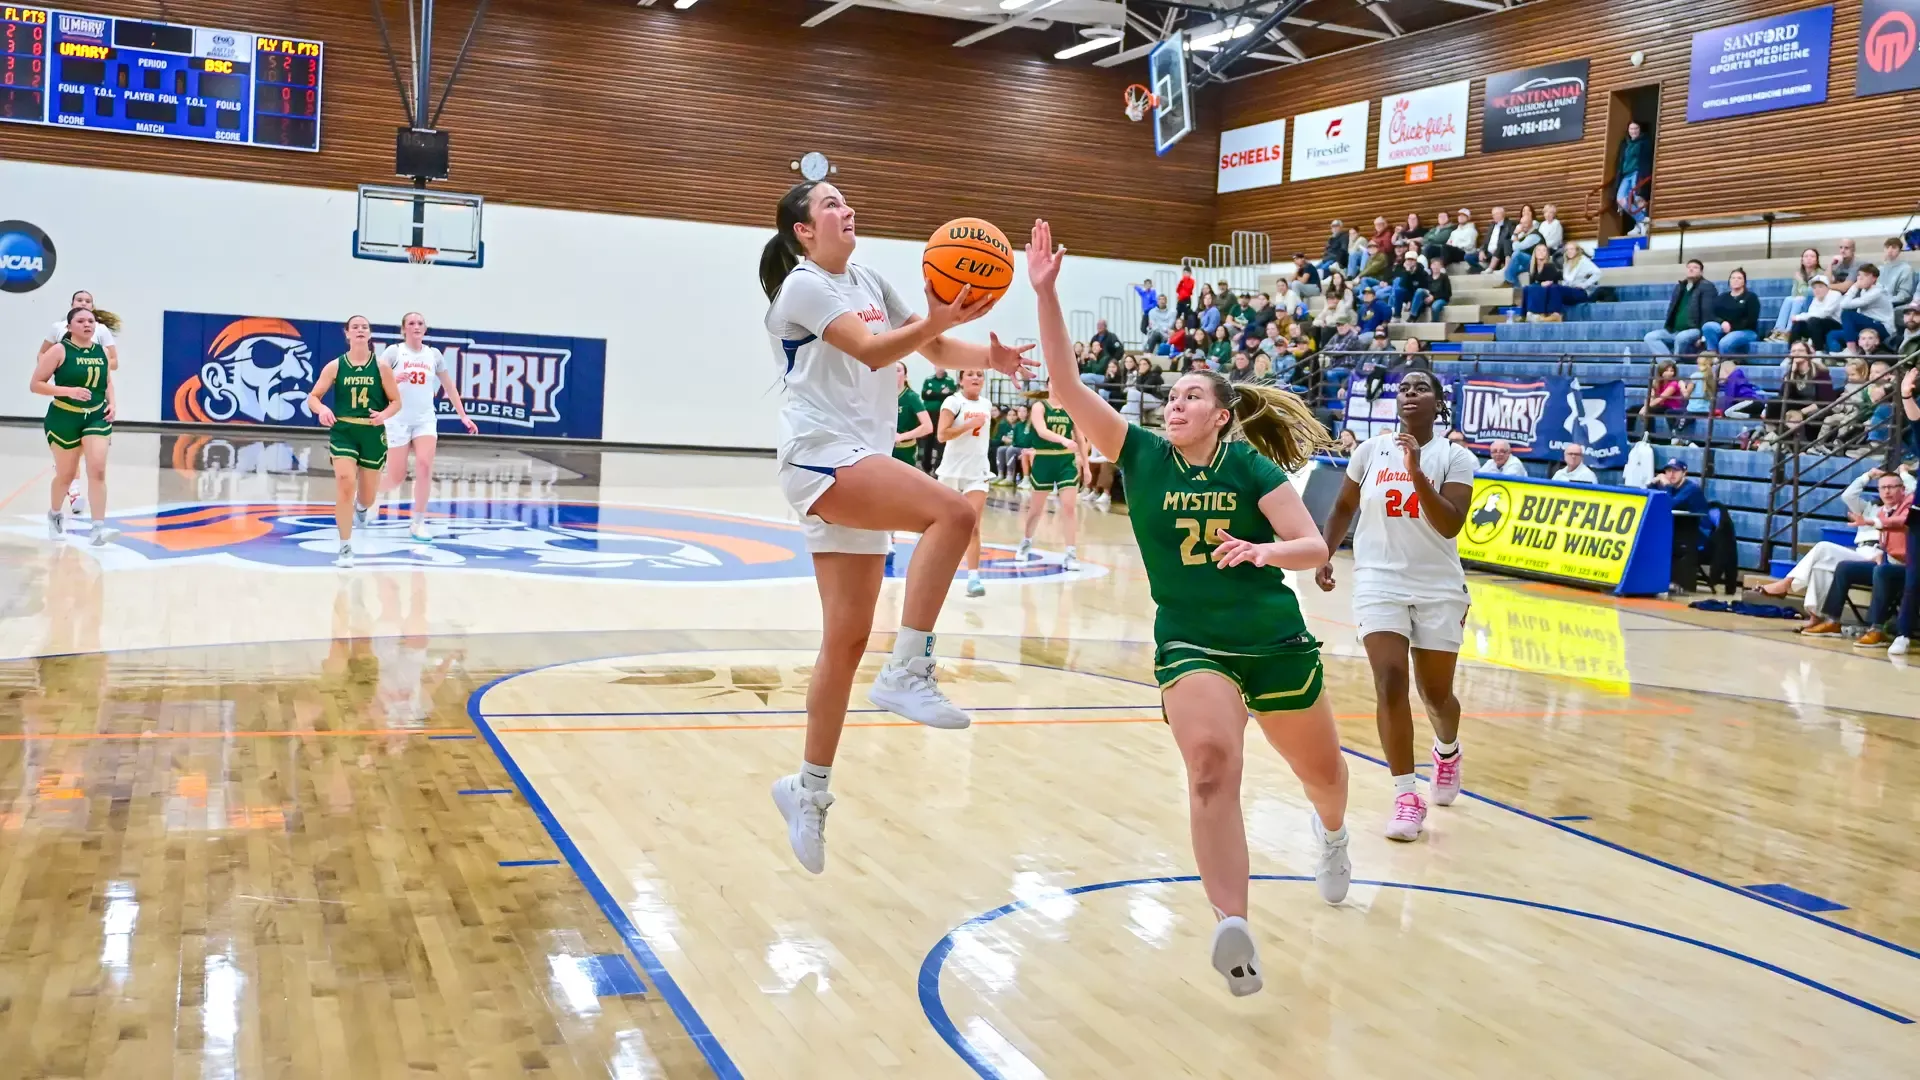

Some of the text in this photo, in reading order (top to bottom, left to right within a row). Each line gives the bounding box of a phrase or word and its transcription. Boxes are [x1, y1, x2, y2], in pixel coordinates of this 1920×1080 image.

[5, 8, 46, 24] FL PTS
[62, 17, 103, 36] UMARY
[257, 38, 318, 56] PLY FL PTS
[1724, 25, 1799, 52] SANFORD
[60, 42, 109, 59] UMARY
[1720, 41, 1799, 63] ORTHOPEDICS
[138, 58, 167, 69] PERIOD
[204, 59, 232, 74] BSC
[1709, 48, 1810, 75] SPORTS MEDICINE
[58, 84, 117, 98] FOULS T.O.L.
[124, 91, 179, 104] PLAYER FOUL
[186, 97, 241, 111] T.O.L. FOULS
[1506, 101, 1545, 115] COLLISION
[58, 115, 85, 126] SCORE
[136, 123, 164, 133] MATCH
[215, 131, 241, 141] SCORE
[1221, 145, 1281, 169] SCHEELS
[1307, 143, 1350, 159] Fireside
[949, 227, 1009, 256] Wilson
[76, 357, 104, 365] MYSTICS
[85, 366, 100, 387] 11
[344, 376, 374, 385] MYSTICS
[373, 344, 558, 412] MARY
[410, 371, 425, 384] 33
[351, 387, 369, 408] 14
[433, 402, 525, 418] RUDERS
[1464, 391, 1543, 435] UMARY
[1480, 430, 1529, 442] MARAUDERS
[1163, 491, 1237, 511] MYSTICS
[1385, 489, 1419, 518] 24
[1518, 495, 1637, 535] BUFFALO
[1175, 518, 1231, 566] 25
[1511, 526, 1627, 561] WILD WINGS
